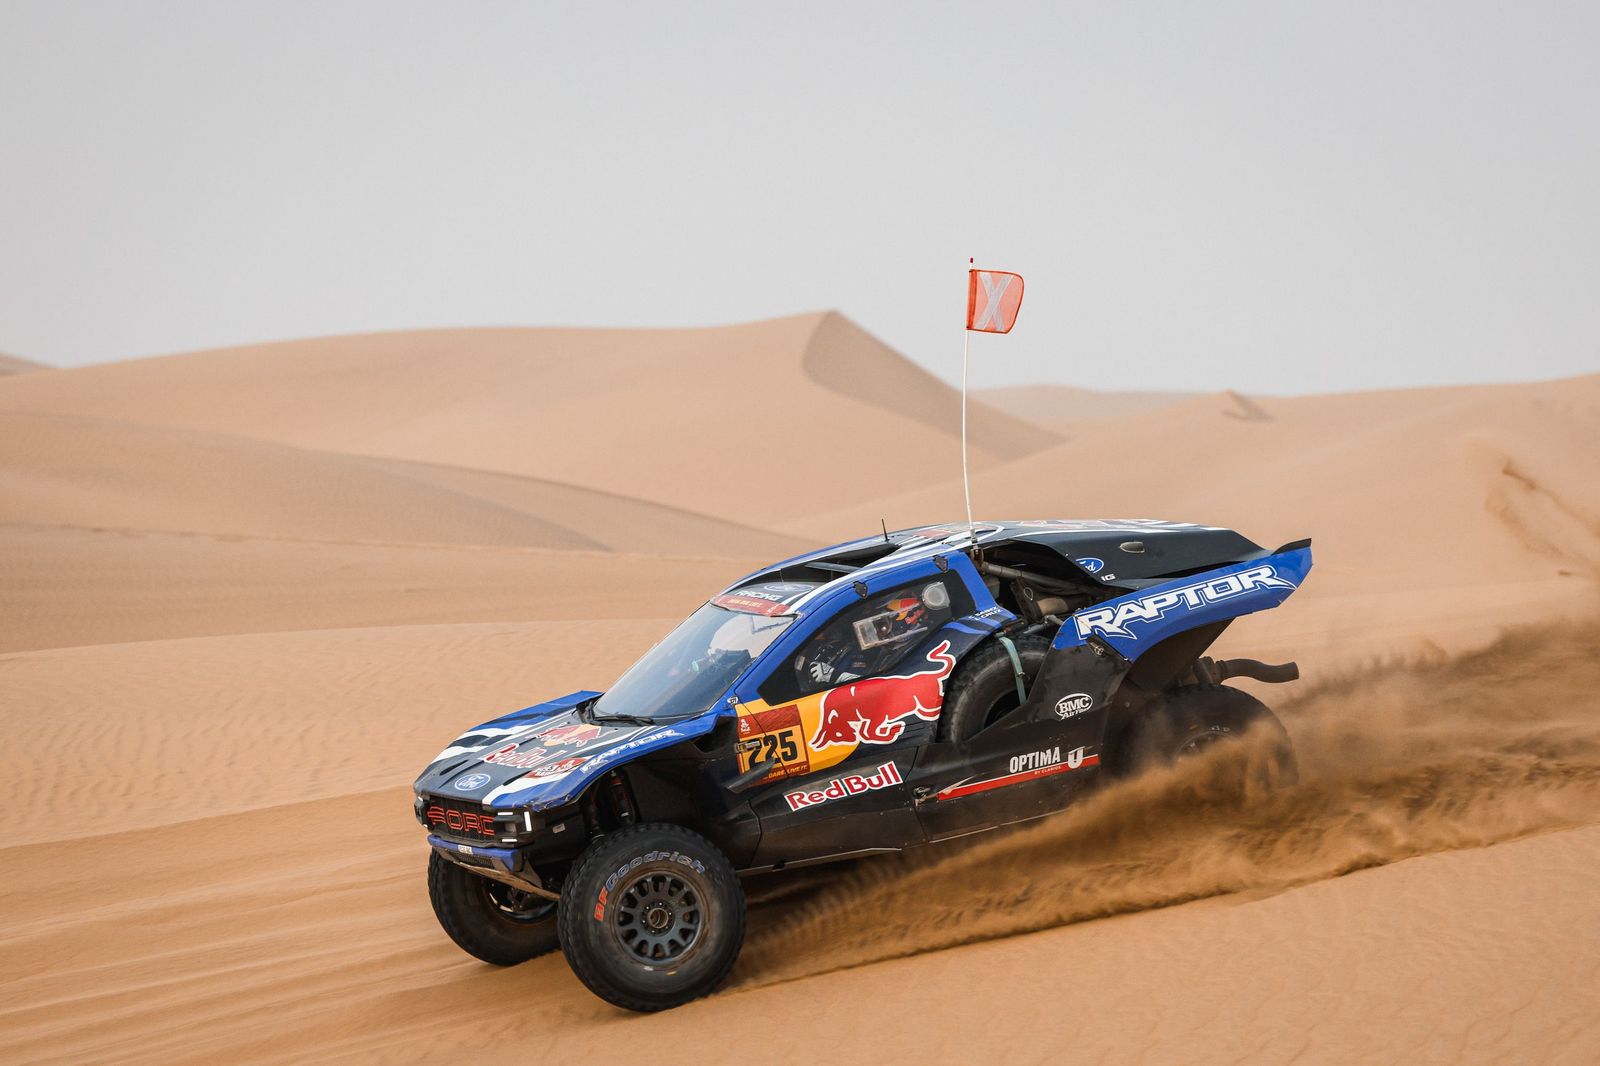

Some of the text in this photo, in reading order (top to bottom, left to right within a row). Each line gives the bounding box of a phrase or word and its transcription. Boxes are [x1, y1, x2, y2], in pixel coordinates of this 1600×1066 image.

[1076, 566, 1296, 638] RAPTOR
[1059, 697, 1090, 713] BMC
[581, 729, 684, 773] RAPTOR
[1009, 747, 1061, 773] OPTIMA
[786, 762, 902, 810] Red Bull
